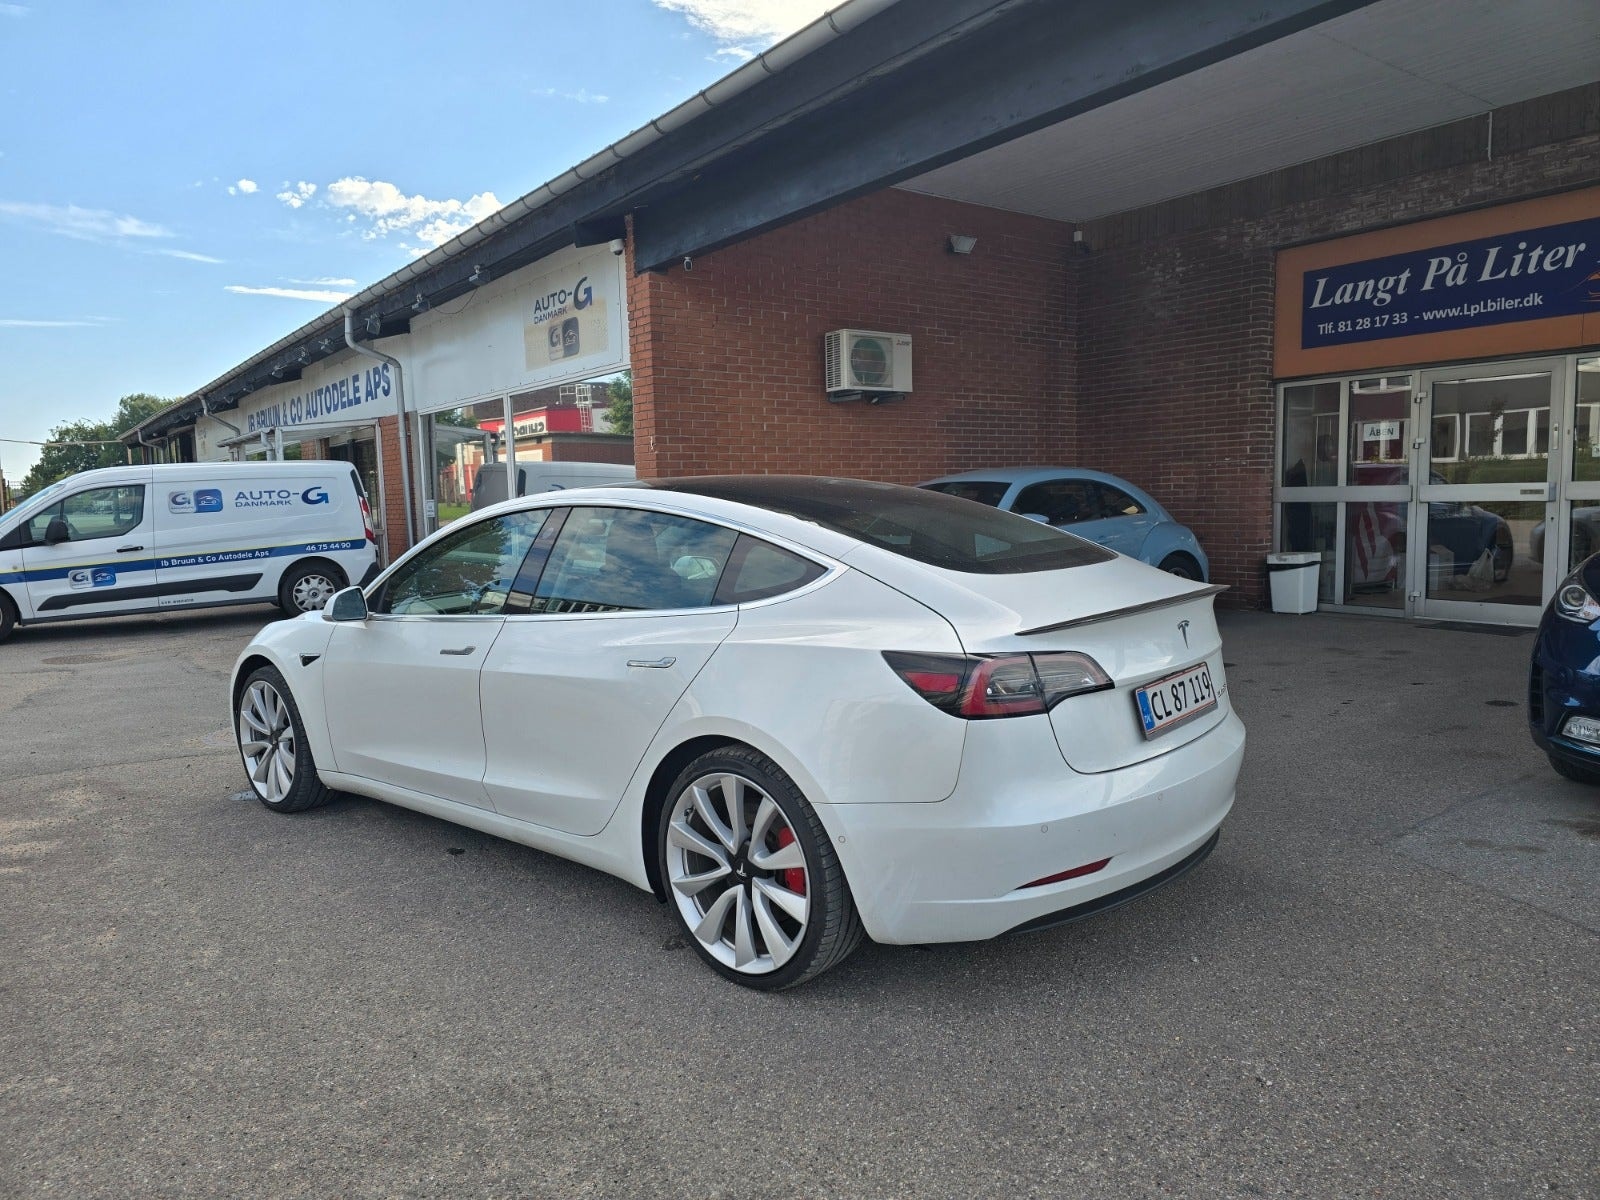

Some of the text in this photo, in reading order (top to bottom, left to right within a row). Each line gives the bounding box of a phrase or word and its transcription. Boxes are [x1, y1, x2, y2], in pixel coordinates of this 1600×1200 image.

[1309, 241, 1587, 309] Langt På Liter
[533, 306, 568, 325] DANMARK
[1318, 321, 1336, 336] Tlf.
[1337, 319, 1353, 333] 81
[1355, 316, 1371, 331] 28
[1374, 314, 1389, 328] 17
[1392, 312, 1408, 326] 33
[1422, 292, 1543, 321] www.LpLbiler.dk
[282, 402, 288, 426] &
[290, 396, 303, 424] CO
[305, 374, 362, 420] AUTODELE
[365, 362, 391, 402] APS
[1369, 426, 1394, 437] ÅBEN
[235, 500, 293, 508] DANMARK
[160, 559, 169, 567] Ib
[171, 557, 196, 566] Bruun
[218, 552, 253, 561] Autodele
[255, 550, 270, 558] Aps
[1151, 689, 1172, 721] CL
[1171, 680, 1188, 713] 87
[1189, 671, 1211, 705] 119
